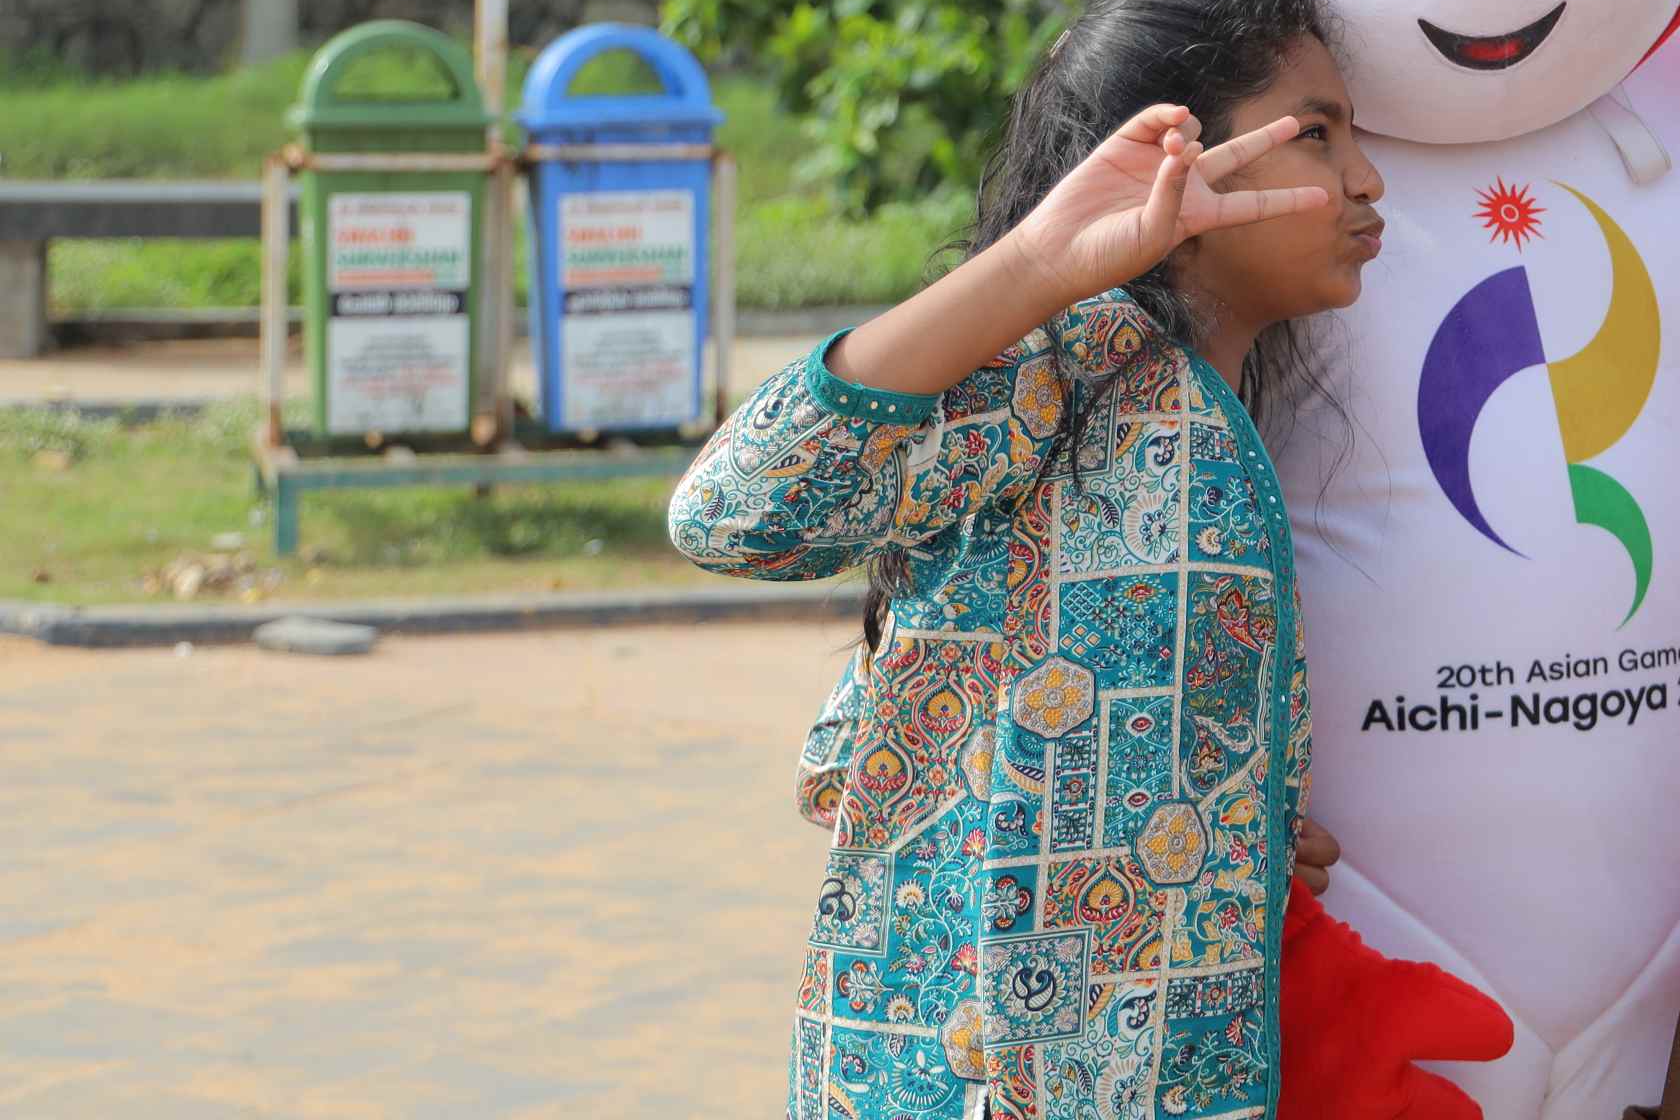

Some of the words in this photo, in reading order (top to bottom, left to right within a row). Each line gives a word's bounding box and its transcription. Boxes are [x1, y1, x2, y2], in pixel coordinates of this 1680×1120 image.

[1436, 661, 1515, 689] 20th
[1526, 654, 1608, 683] Asian
[1361, 682, 1669, 732] Aichi-Nagoya
